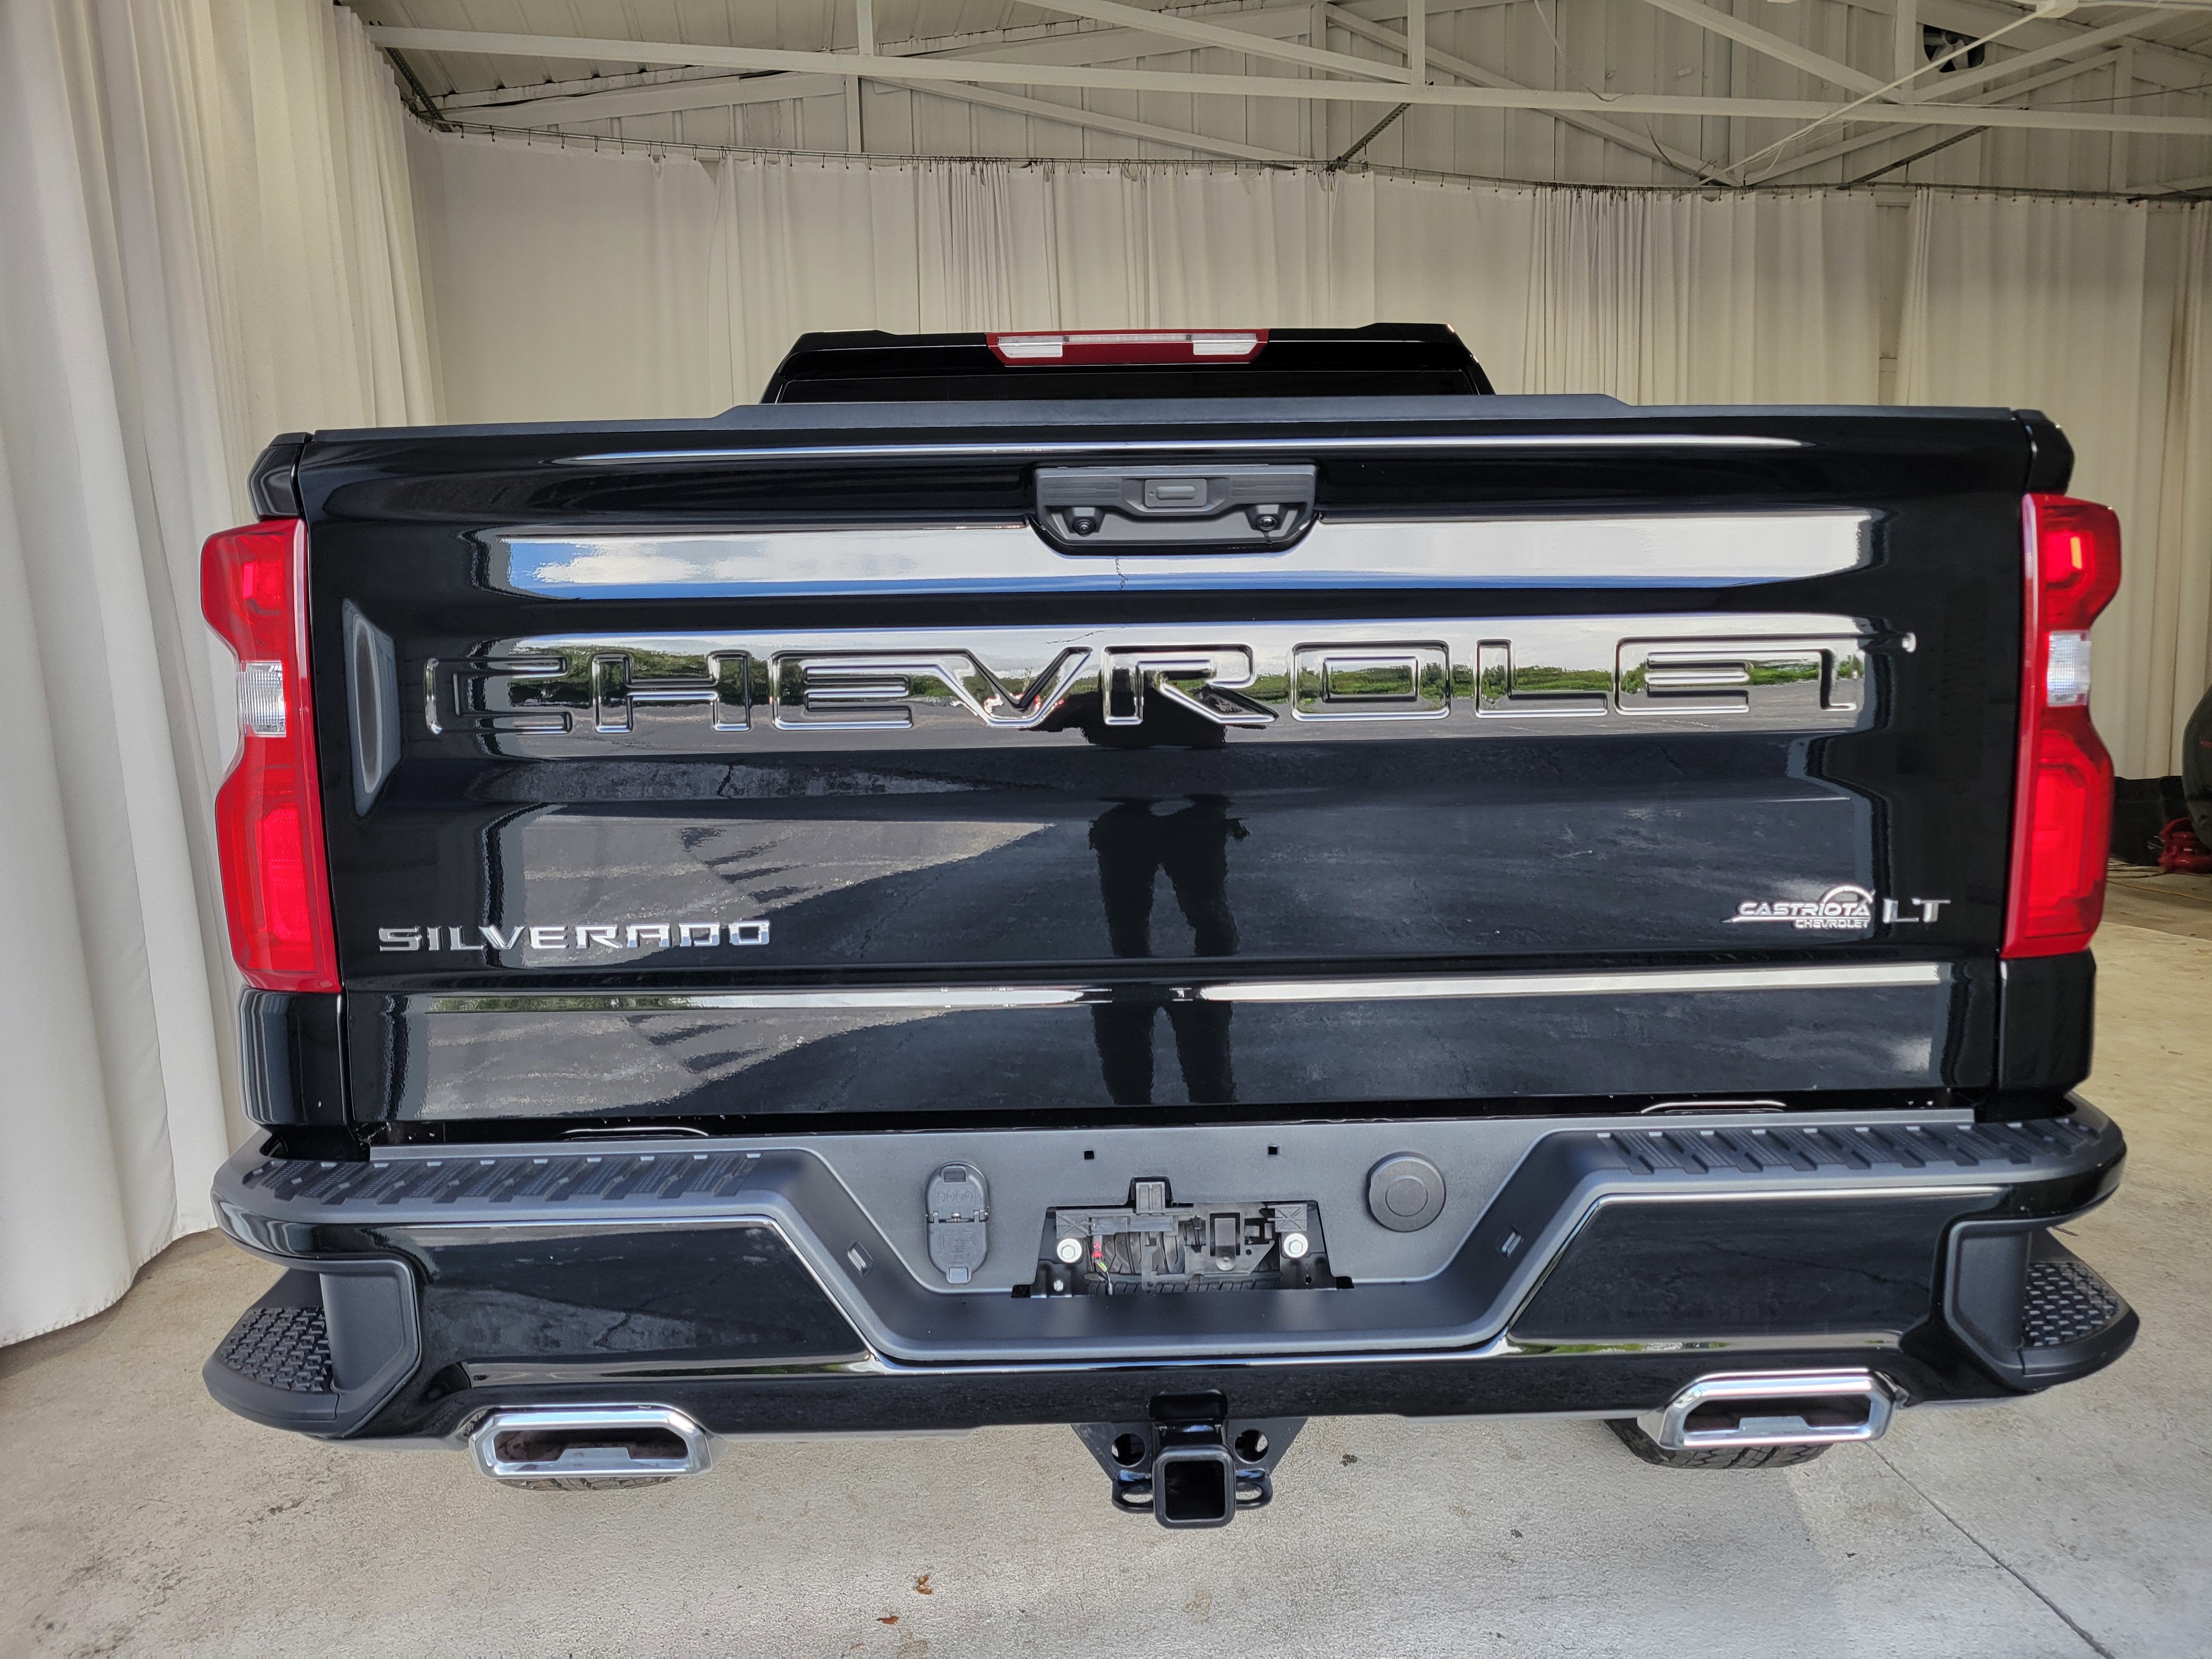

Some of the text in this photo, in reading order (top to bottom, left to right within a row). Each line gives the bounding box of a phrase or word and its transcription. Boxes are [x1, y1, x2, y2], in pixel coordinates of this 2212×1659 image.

[424, 632, 1917, 735] CHEVROLET
[1739, 902, 1871, 917] CASTRIOTA
[1882, 898, 1951, 924] LT
[379, 921, 770, 952] SILVERADO
[1795, 919, 1870, 929] CHEVROLET
